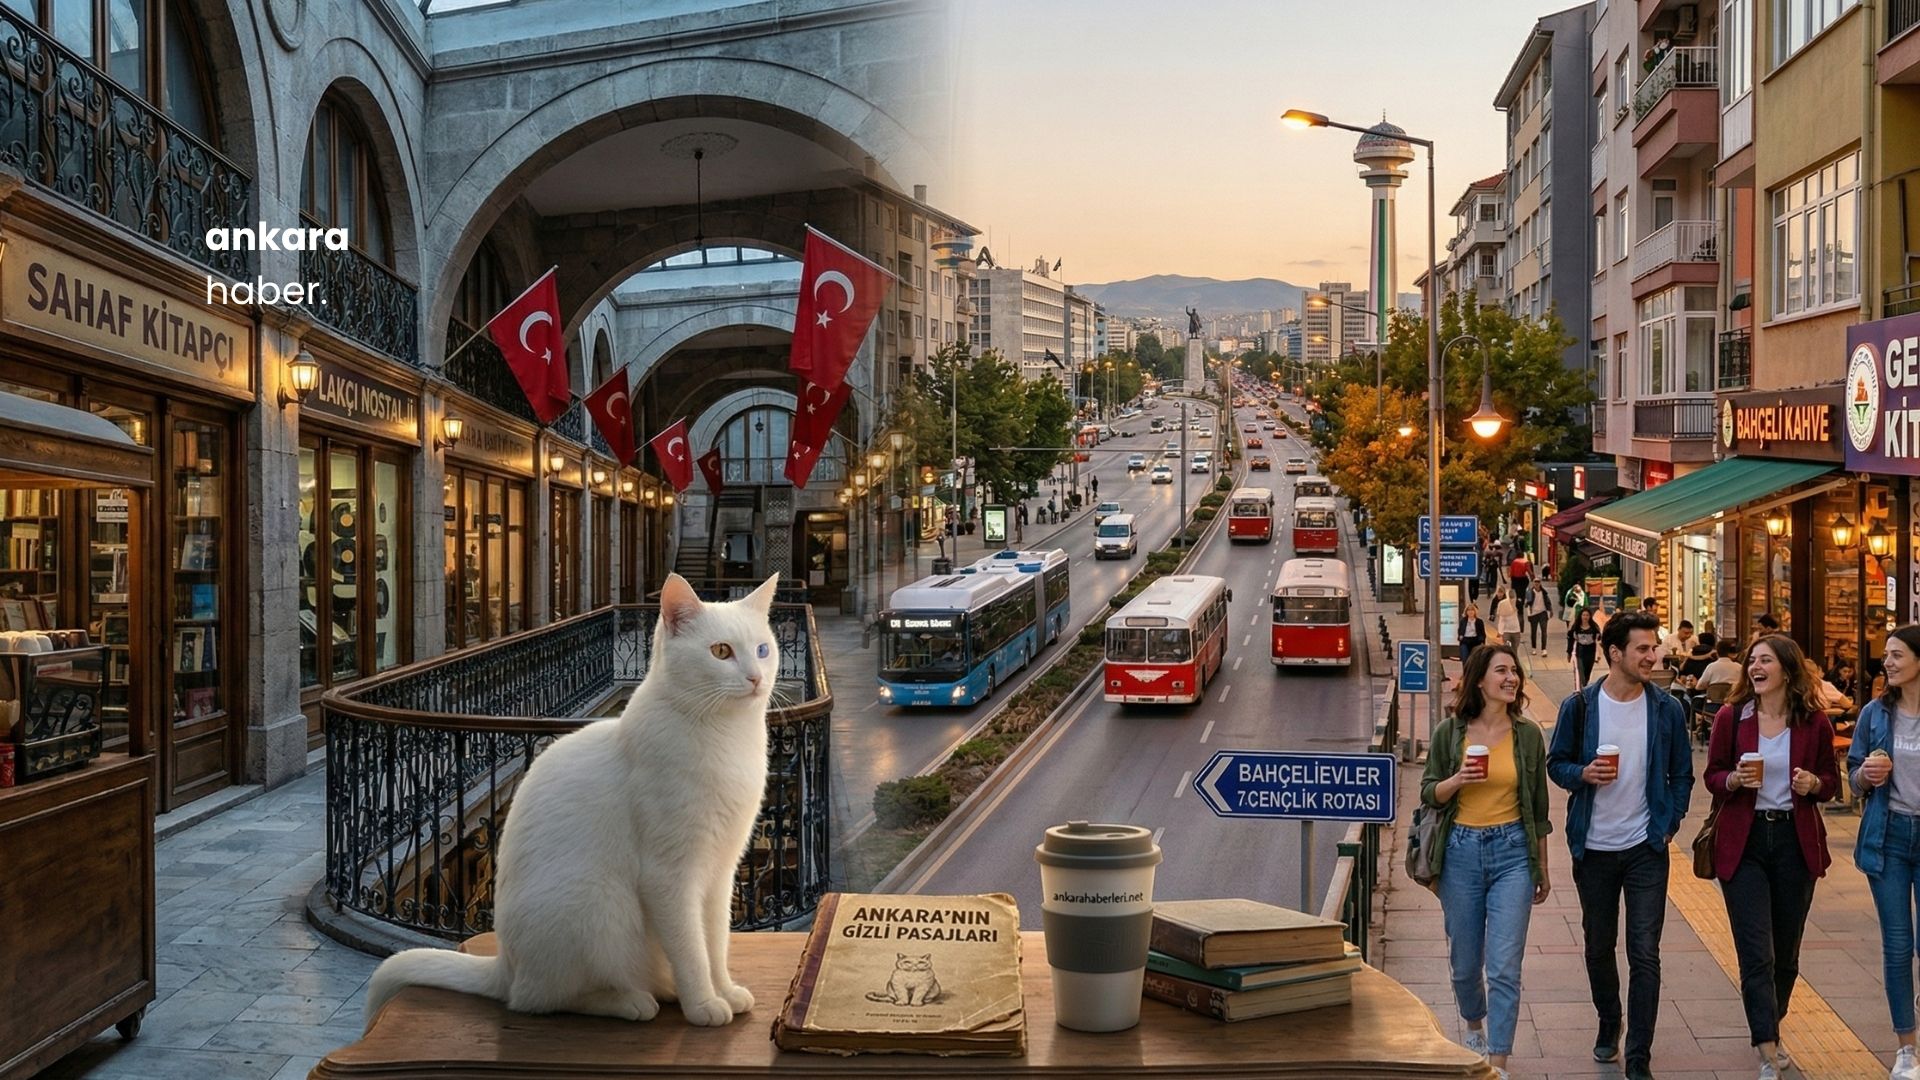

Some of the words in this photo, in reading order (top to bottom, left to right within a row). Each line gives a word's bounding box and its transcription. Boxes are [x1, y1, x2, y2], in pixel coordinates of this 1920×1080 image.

[27, 261, 134, 338] SAHAF
[142, 299, 235, 378] KİTAPÇI
[1885, 336, 1920, 389] GE
[317, 369, 359, 418] LAKÇI
[1736, 399, 1783, 450] BAHÇELİ
[1785, 404, 1829, 442] KAHVE
[1238, 761, 1381, 788] BAHÇELİEVLER
[1322, 792, 1381, 811] ROTASI
[1053, 891, 1144, 904] ankarahaberleri.net
[852, 907, 991, 926] ANKARA'NIN
[842, 922, 891, 940] GİZLİ
[896, 925, 999, 943] PASAJLARI
